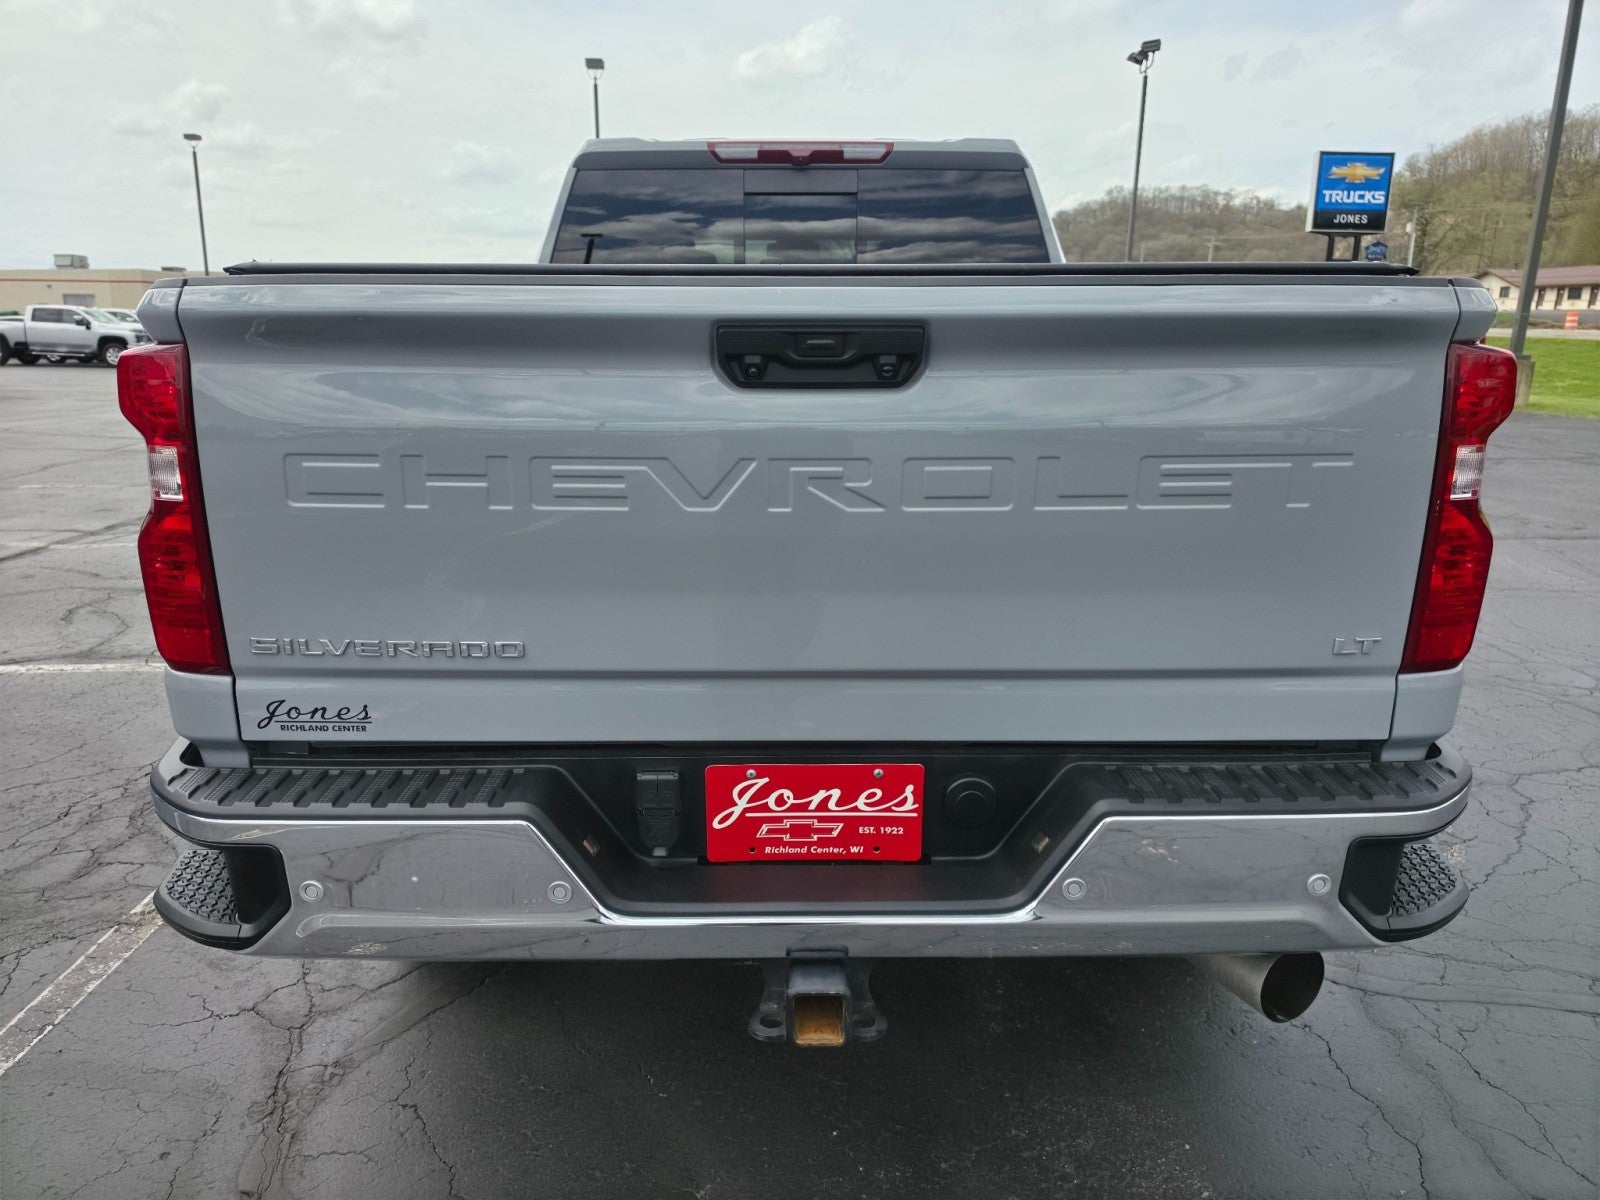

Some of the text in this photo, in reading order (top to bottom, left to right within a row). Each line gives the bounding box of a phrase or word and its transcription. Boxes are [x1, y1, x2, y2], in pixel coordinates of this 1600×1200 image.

[1323, 190, 1386, 204] TRUCKS
[1333, 213, 1368, 224] JONES
[283, 453, 1354, 512] CHEVROLET
[250, 636, 526, 658] SILVERADO
[1332, 637, 1382, 655] LT
[257, 699, 373, 729] Jones
[280, 724, 367, 732] RICHLAND CENTER
[712, 777, 919, 830] Jones
[858, 826, 904, 835] EST. 1922
[764, 845, 864, 856] Richland Center, WI
